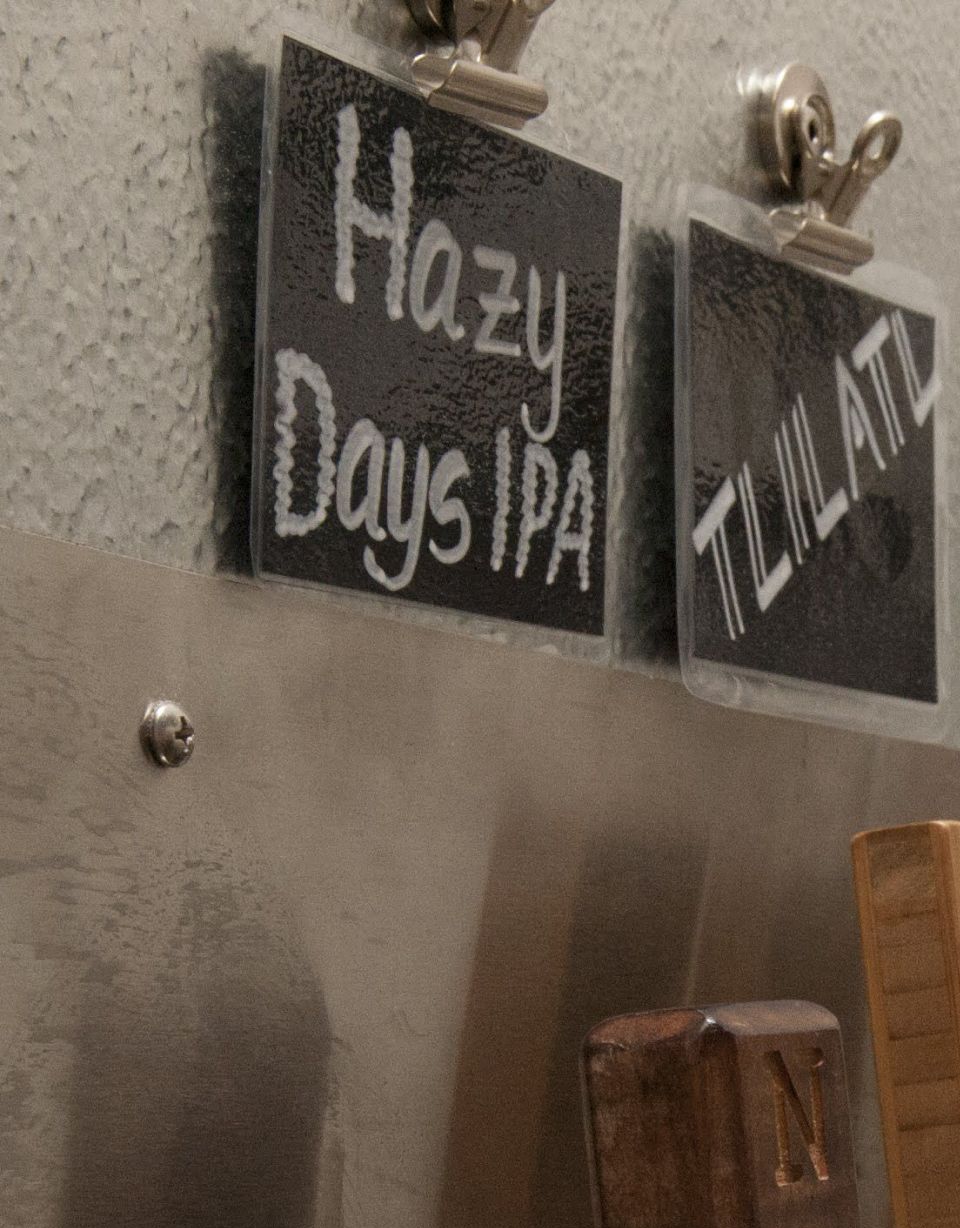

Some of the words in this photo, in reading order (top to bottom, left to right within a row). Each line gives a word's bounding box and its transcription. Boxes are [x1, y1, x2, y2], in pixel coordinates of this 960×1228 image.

[334, 103, 566, 443] Hazy
[274, 347, 471, 591] Days
[491, 426, 594, 591] IPA
